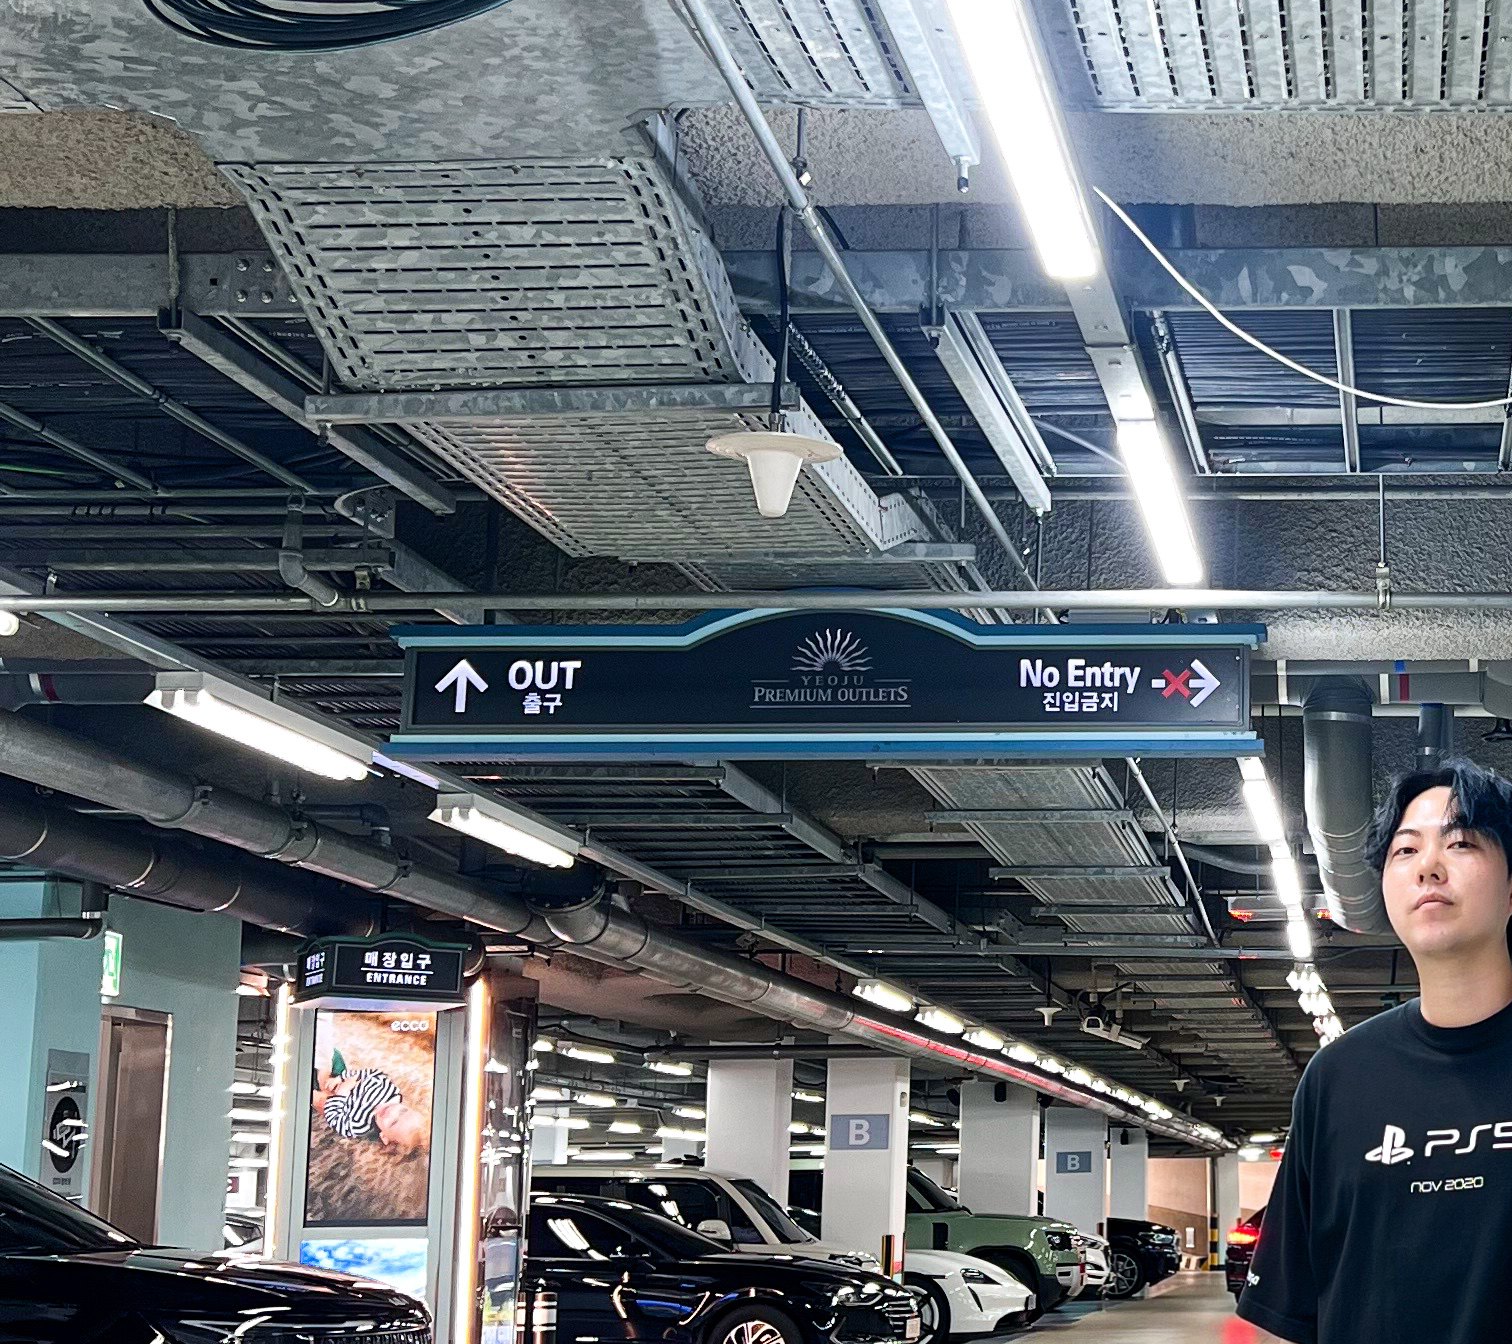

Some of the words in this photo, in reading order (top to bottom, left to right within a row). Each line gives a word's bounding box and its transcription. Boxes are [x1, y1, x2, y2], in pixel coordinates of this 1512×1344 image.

[508, 660, 582, 690] OUT
[801, 675, 864, 686] YEOJU
[1019, 659, 1060, 688] No
[1067, 658, 1141, 694] Entry
[753, 687, 832, 702] PREMIUM
[837, 686, 908, 702] OUTLETS
[1042, 691, 1119, 712] 진입금지
[522, 692, 563, 714] 출구
[364, 951, 432, 969] 매장입구
[366, 972, 427, 986] ENTRANCE
[391, 1020, 430, 1032] ecco
[848, 1119, 871, 1146] B
[1066, 1154, 1080, 1171] B
[1444, 1176, 1484, 1191] 2020
